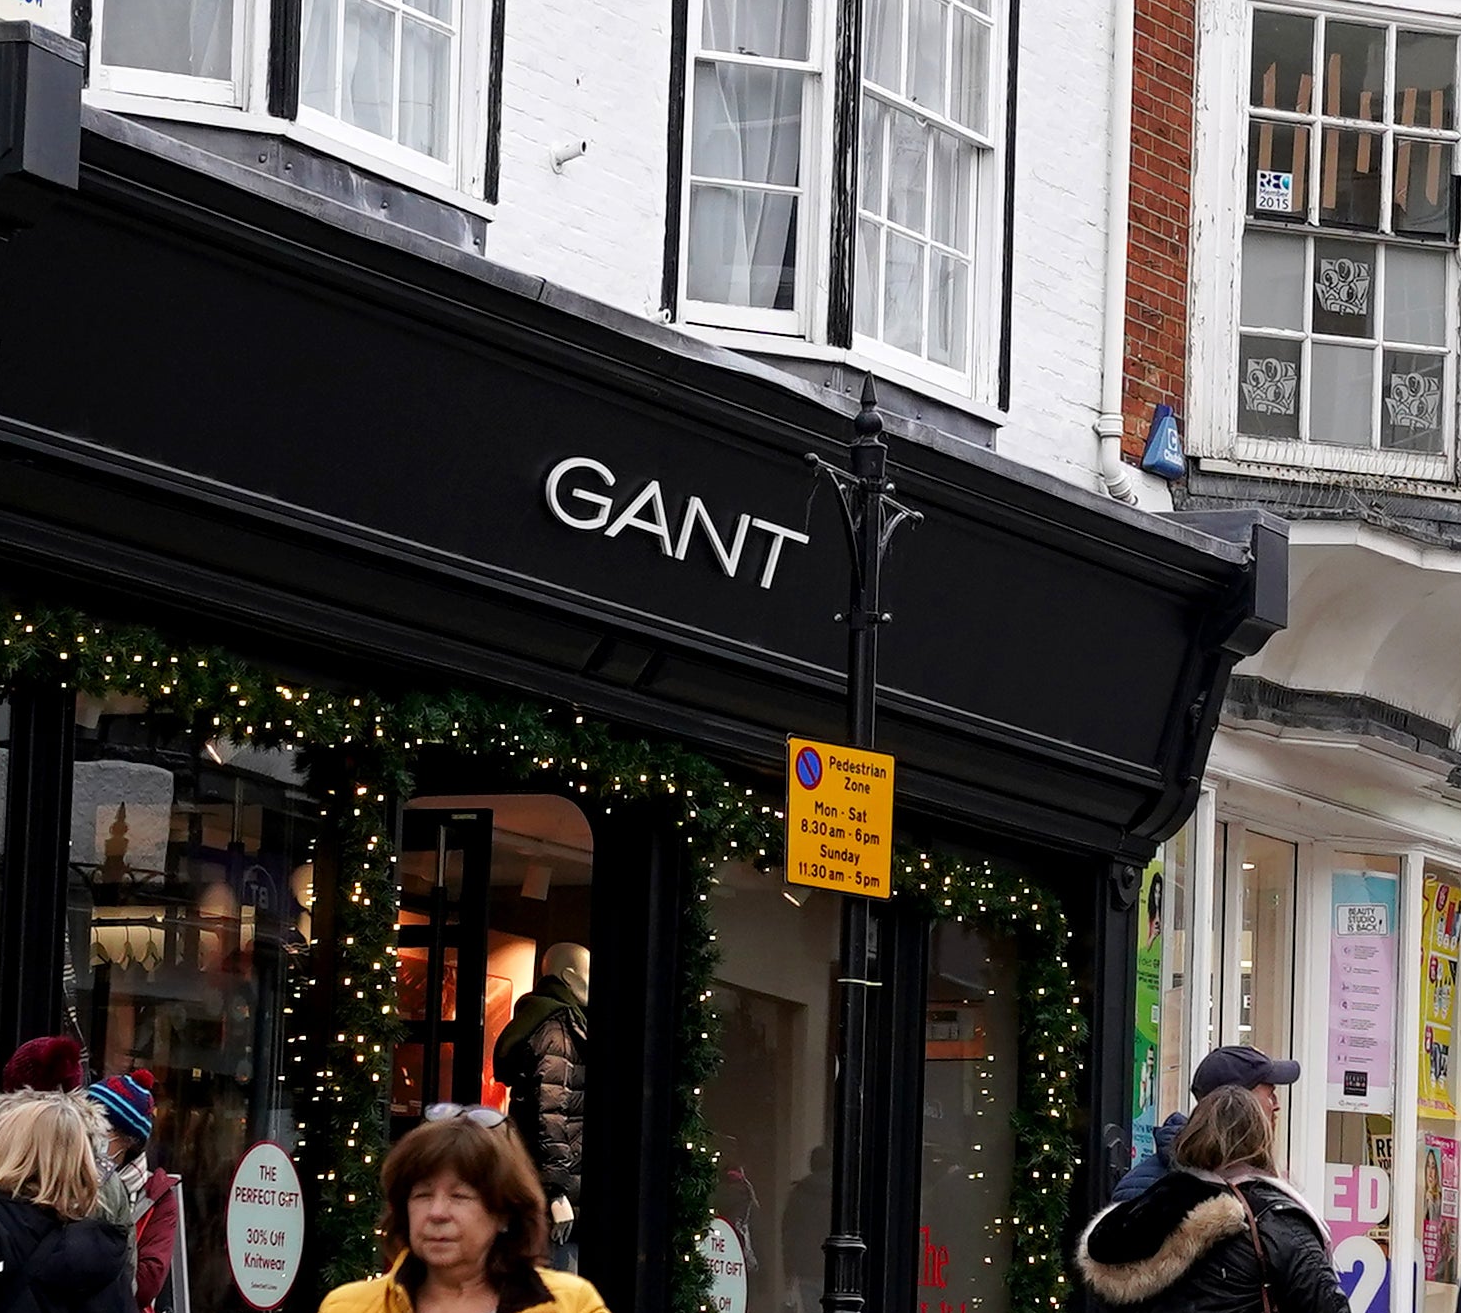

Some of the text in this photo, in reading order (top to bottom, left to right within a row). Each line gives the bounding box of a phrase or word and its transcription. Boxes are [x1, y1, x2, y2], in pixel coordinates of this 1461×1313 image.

[1259, 196, 1289, 210] 2015
[545, 456, 810, 589] GANT
[829, 755, 887, 779] Pedestrian
[844, 777, 871, 794] Zone
[814, 801, 838, 818] Mon
[848, 807, 867, 824] Sat
[820, 844, 860, 866] Sunday
[1348, 907, 1376, 916] BEAUTY
[1348, 915, 1377, 924] STUDIO
[259, 1165, 277, 1182] THE
[235, 1186, 300, 1209] PERFECT GIFT
[246, 1228, 285, 1247] 30% Off
[711, 1238, 726, 1253] THE
[244, 1252, 286, 1271] Knitwear
